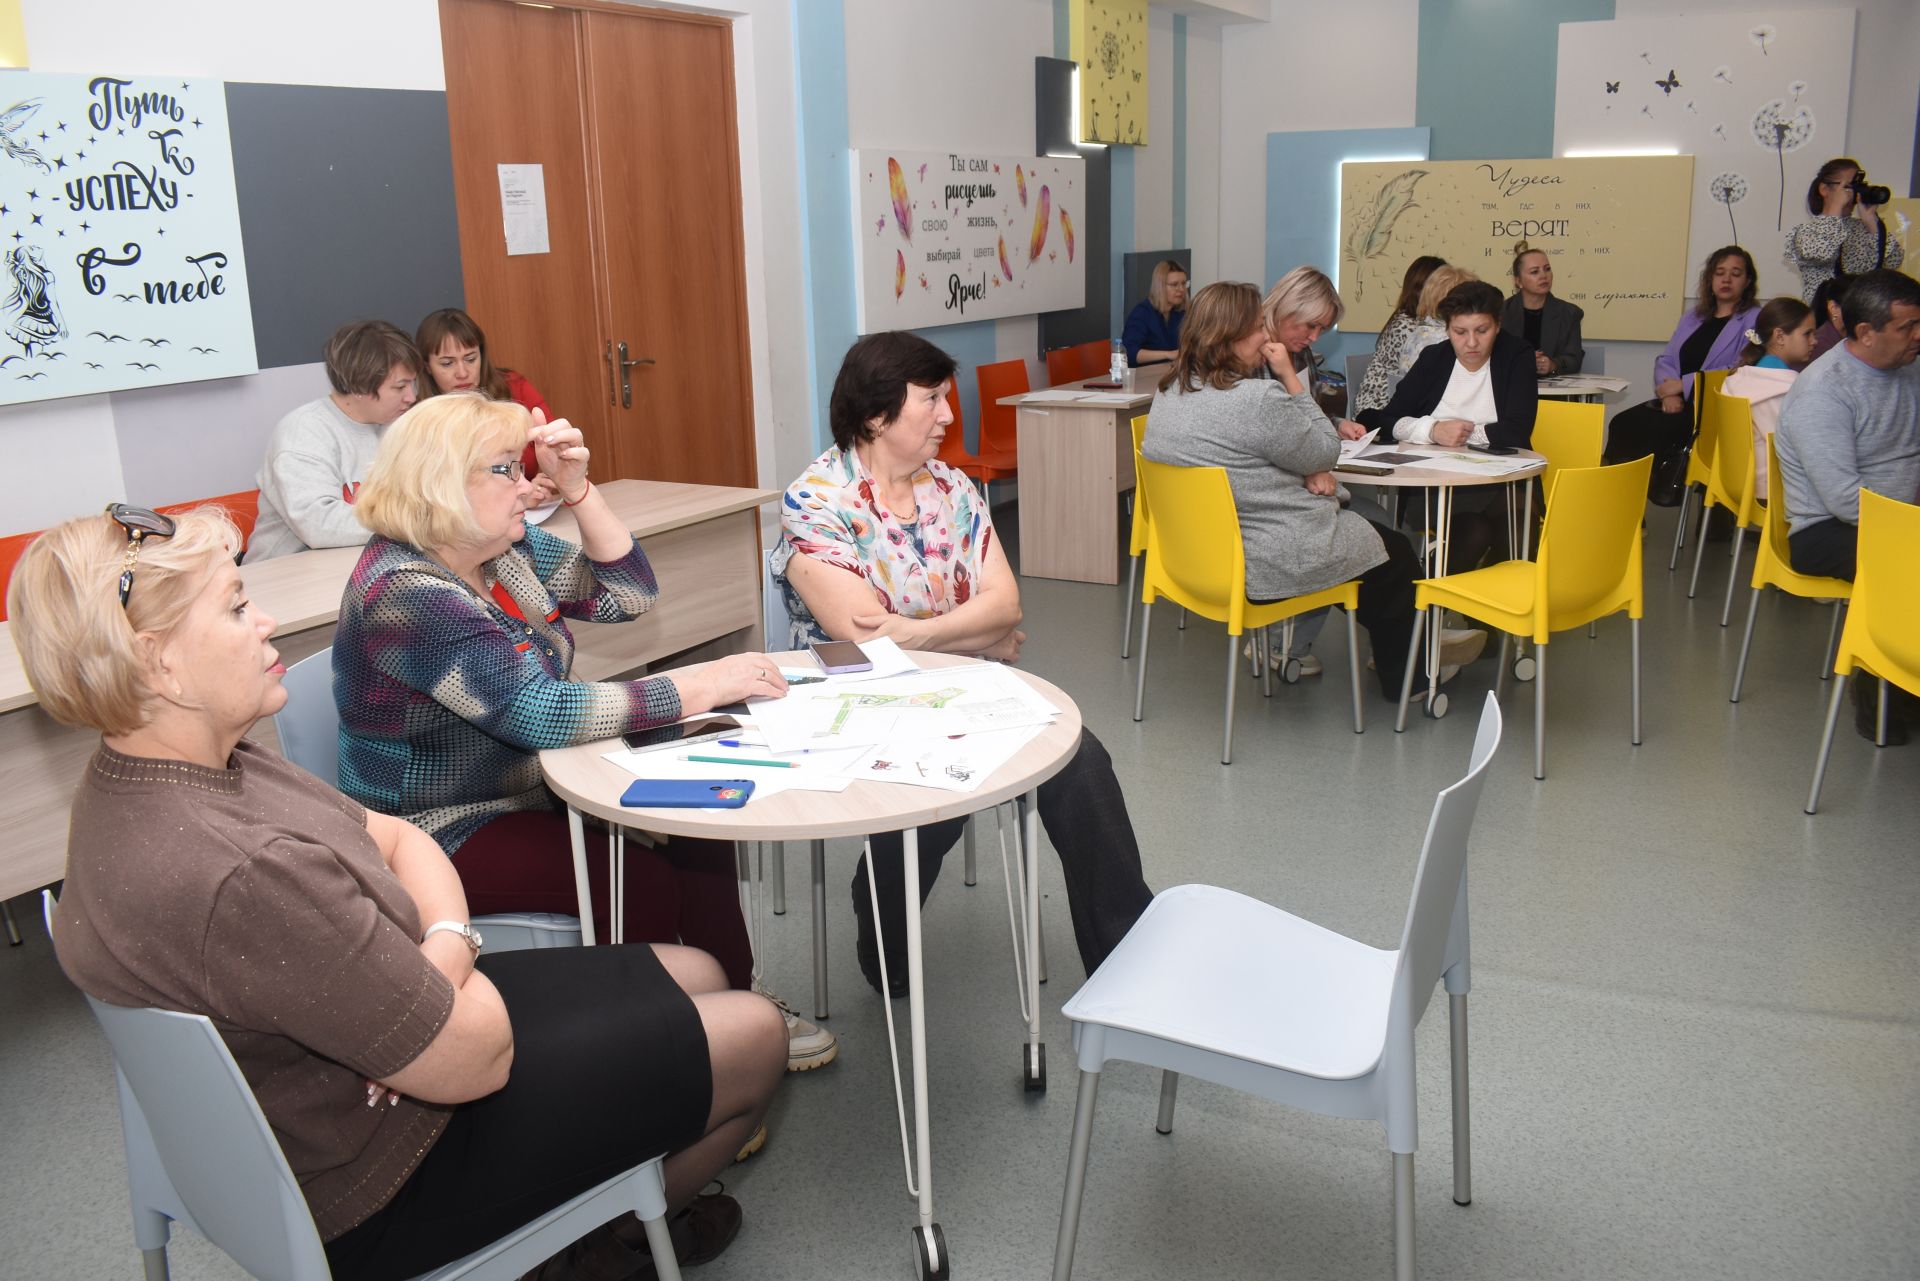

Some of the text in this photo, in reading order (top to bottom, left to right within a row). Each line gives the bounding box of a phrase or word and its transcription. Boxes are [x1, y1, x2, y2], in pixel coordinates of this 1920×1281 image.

[88, 76, 184, 131] Путь
[945, 183, 996, 210] рисуешь
[1475, 164, 1566, 198] Чудеса
[967, 215, 998, 228] жизнь,
[926, 247, 995, 264] выбирай цвета
[143, 251, 228, 305] тебе
[945, 271, 986, 315] Ярче!
